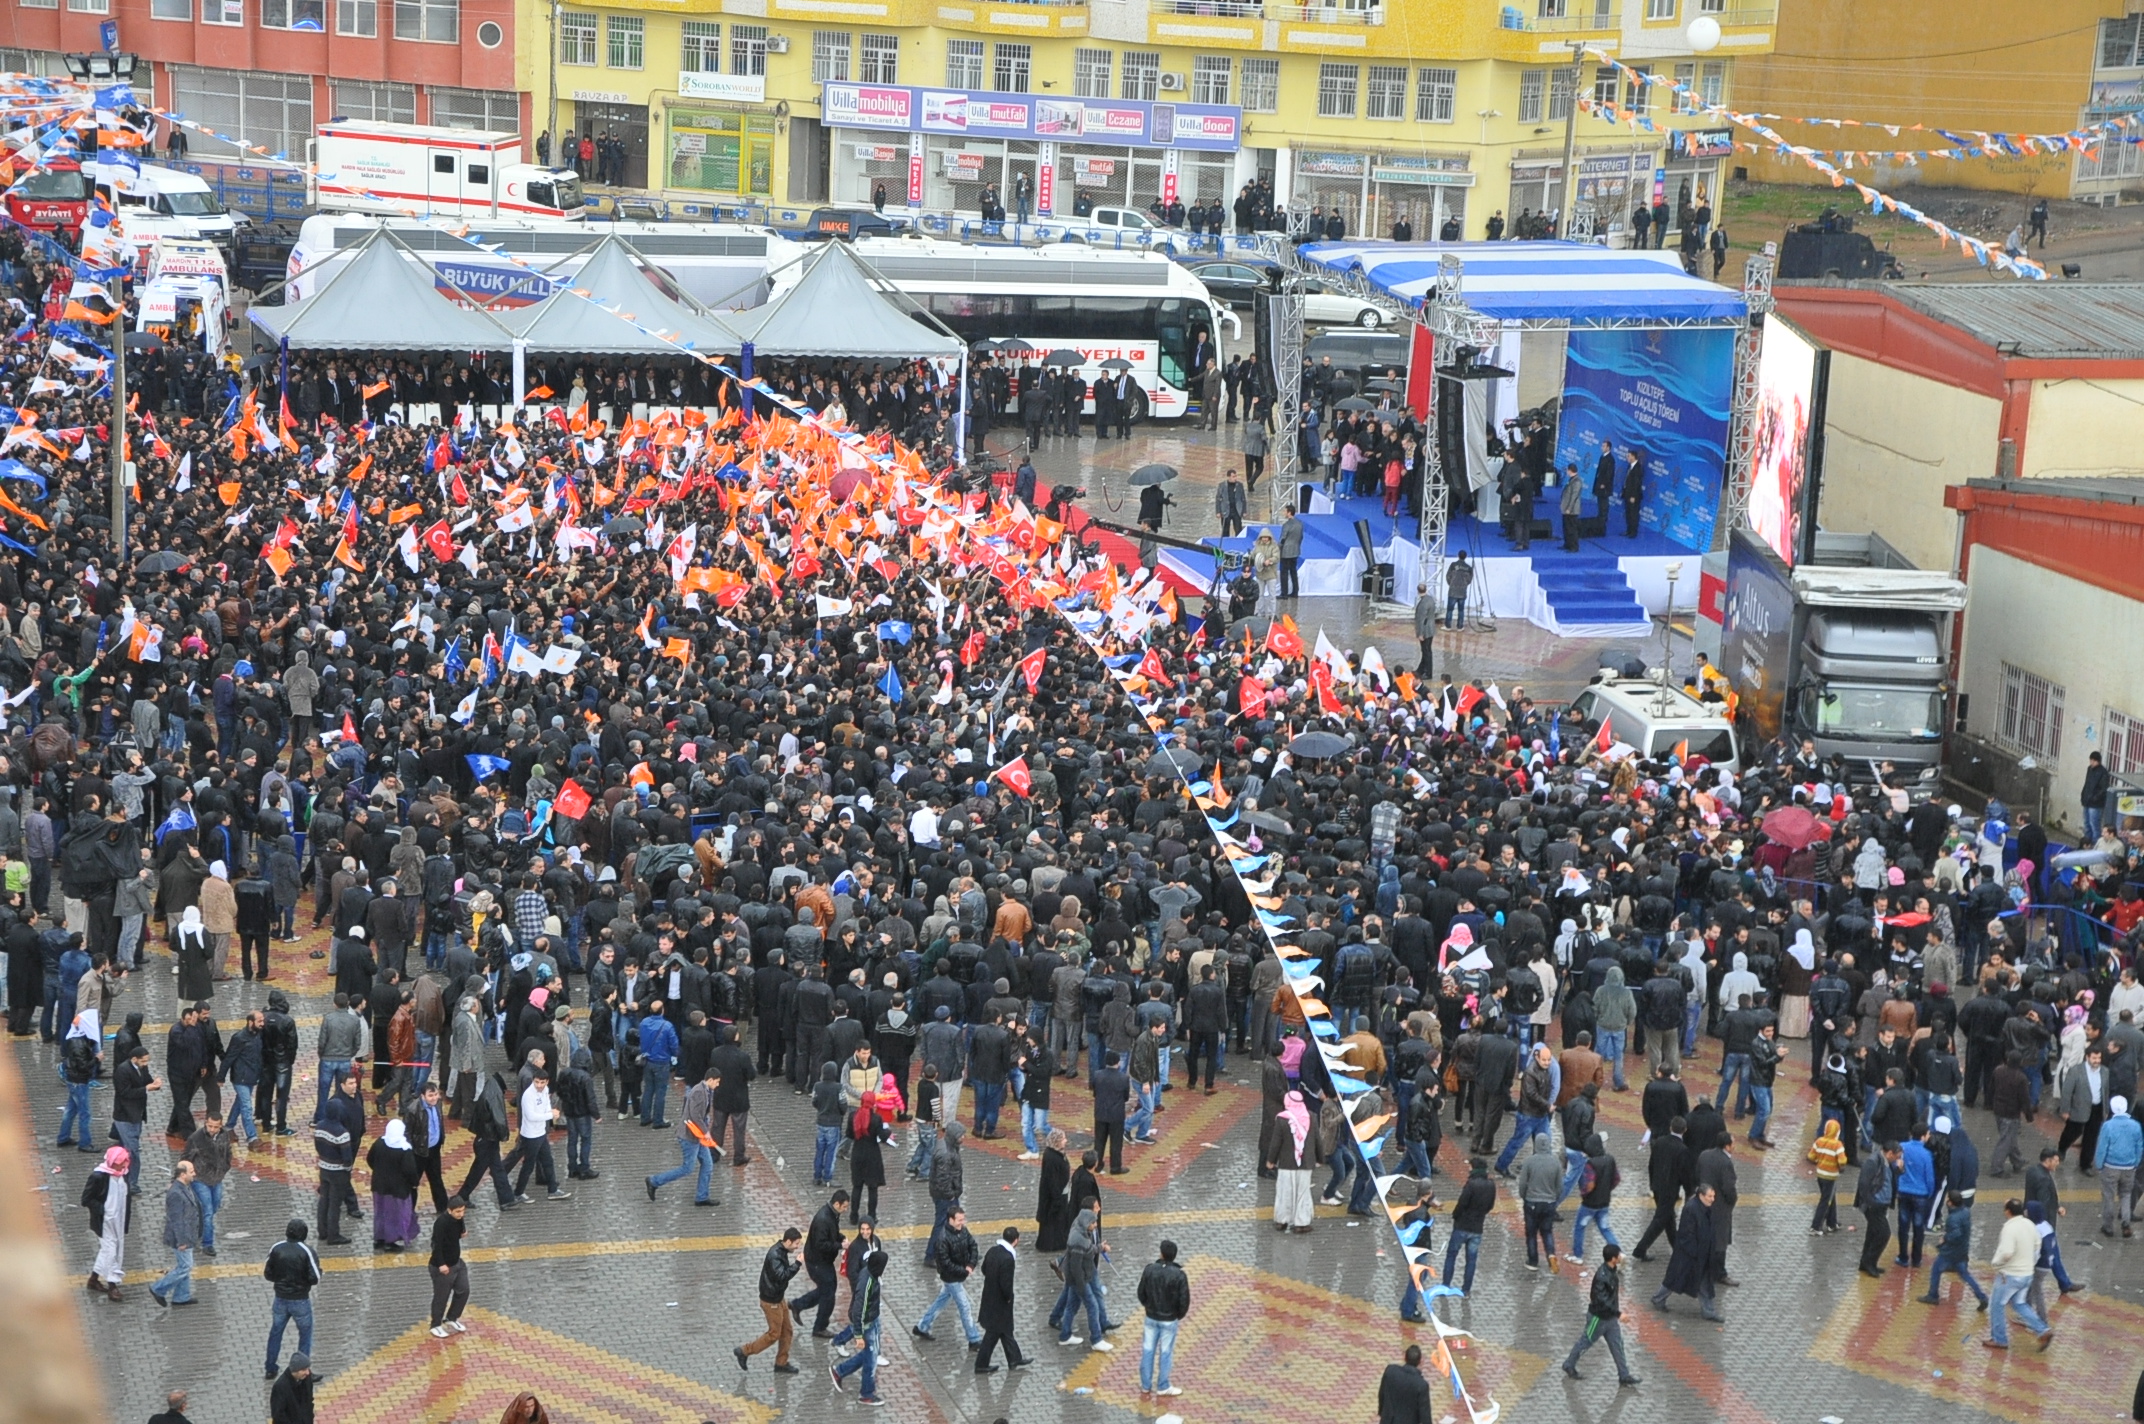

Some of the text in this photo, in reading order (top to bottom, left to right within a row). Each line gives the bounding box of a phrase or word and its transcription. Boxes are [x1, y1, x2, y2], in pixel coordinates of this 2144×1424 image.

[574, 91, 628, 102] RAVZA AP
[832, 90, 907, 117] Villa mobilya
[831, 113, 856, 123] Sanayi
[868, 116, 892, 125] Ticaret
[971, 105, 1025, 121] Villa mutfak
[1087, 112, 1141, 127] Villa Eczane
[1179, 118, 1231, 132] Villa door
[820, 220, 850, 232] UMKE
[161, 265, 224, 274] AMBULANS
[444, 267, 507, 291] BÜYÜK
[1620, 388, 1640, 407] TOPLU
[1742, 582, 1770, 639] Altus
